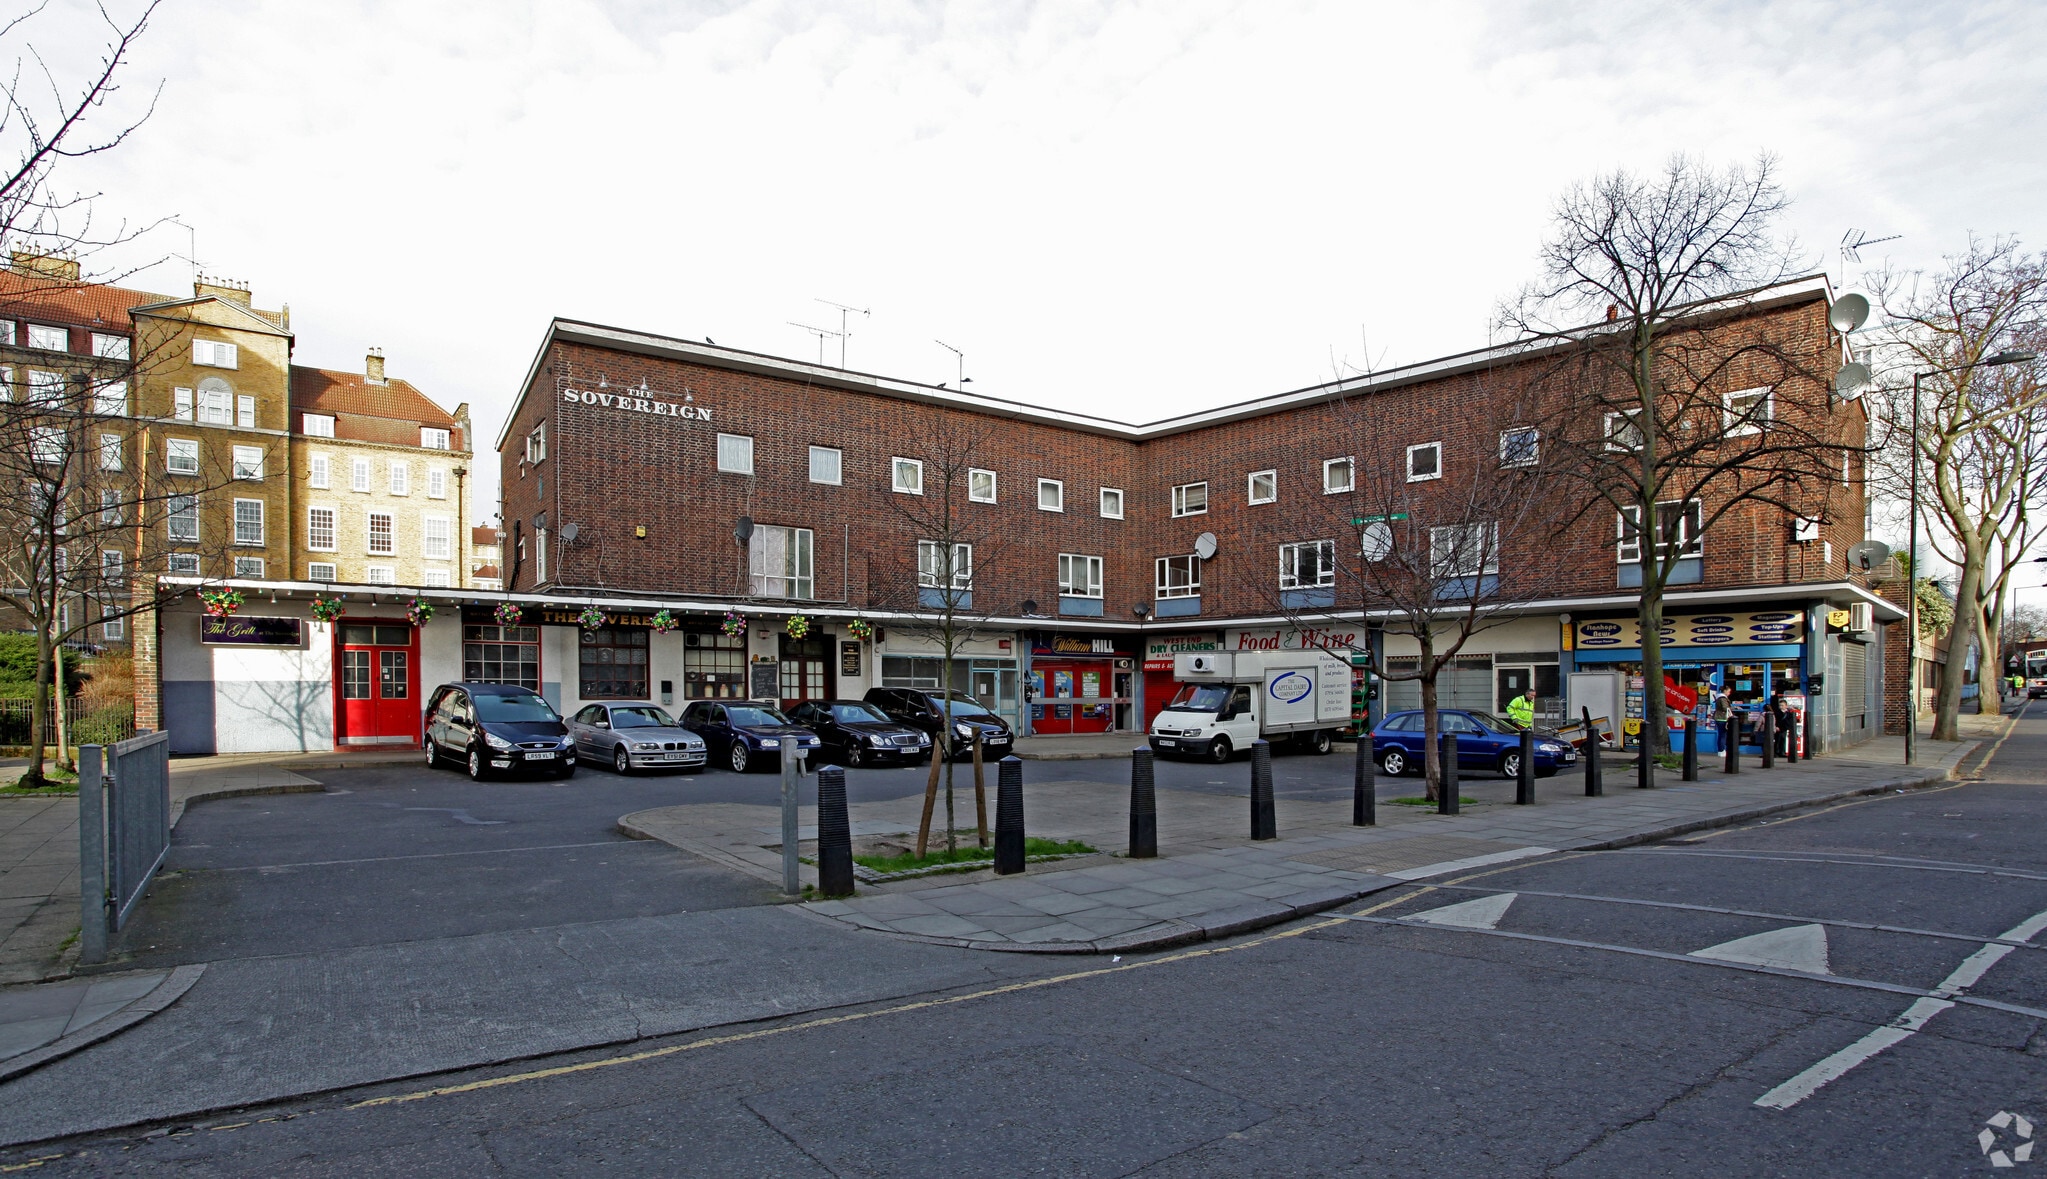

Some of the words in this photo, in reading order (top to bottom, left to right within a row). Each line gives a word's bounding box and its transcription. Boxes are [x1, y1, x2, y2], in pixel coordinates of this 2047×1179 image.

[627, 388, 653, 399] THE
[564, 388, 712, 421] SOVEREIGN
[542, 611, 577, 623] THE
[204, 619, 226, 634] The
[227, 622, 256, 638] Grill
[1586, 624, 1617, 632] Stanhope
[1052, 636, 1091, 653] William
[1092, 639, 1114, 653] HILL
[1163, 636, 1184, 644] WEST
[1186, 635, 1202, 643] END
[1238, 631, 1281, 650] Food
[1300, 628, 1356, 649] Wine
[1150, 644, 1168, 654] DRY
[1170, 642, 1216, 652] CLEANERS
